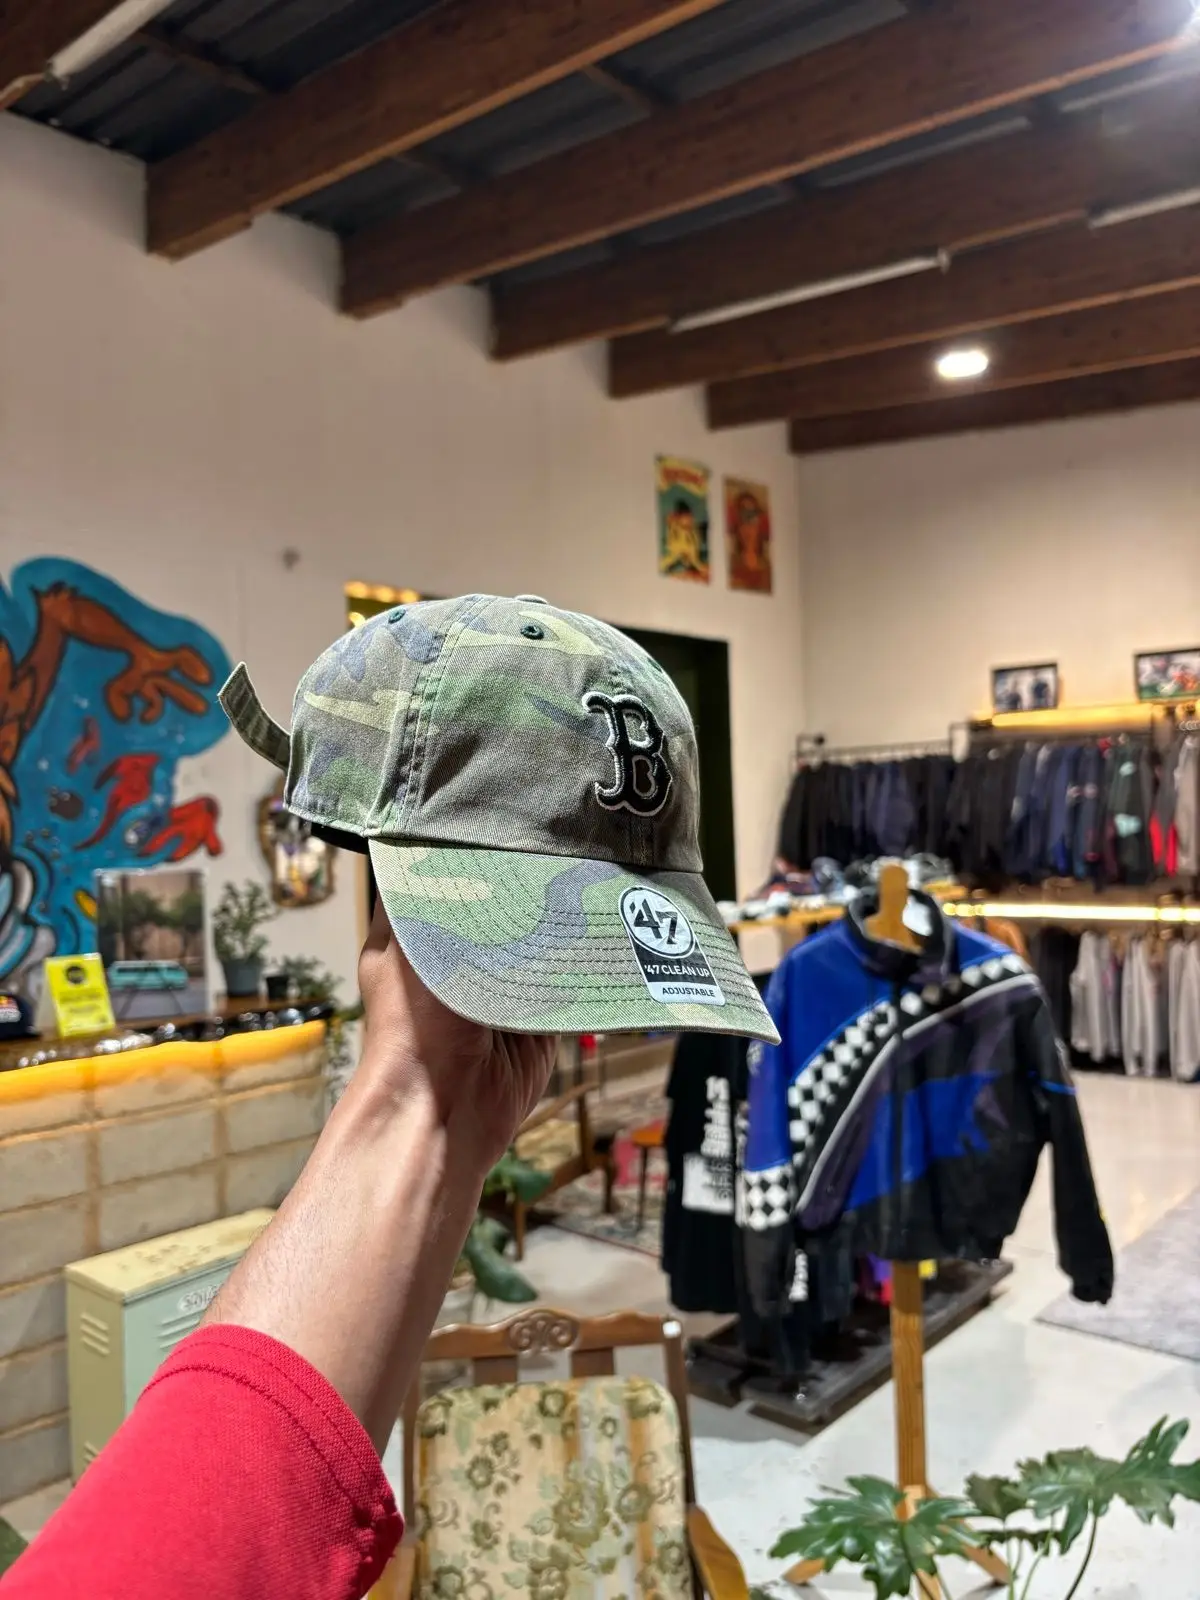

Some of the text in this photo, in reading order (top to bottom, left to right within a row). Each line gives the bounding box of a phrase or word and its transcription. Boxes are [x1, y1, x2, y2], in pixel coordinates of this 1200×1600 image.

[582, 691, 673, 817] B
[661, 964, 697, 976] CLEAN
[696, 966, 710, 978] UP
[662, 987, 716, 998] ADJUSTABLE
